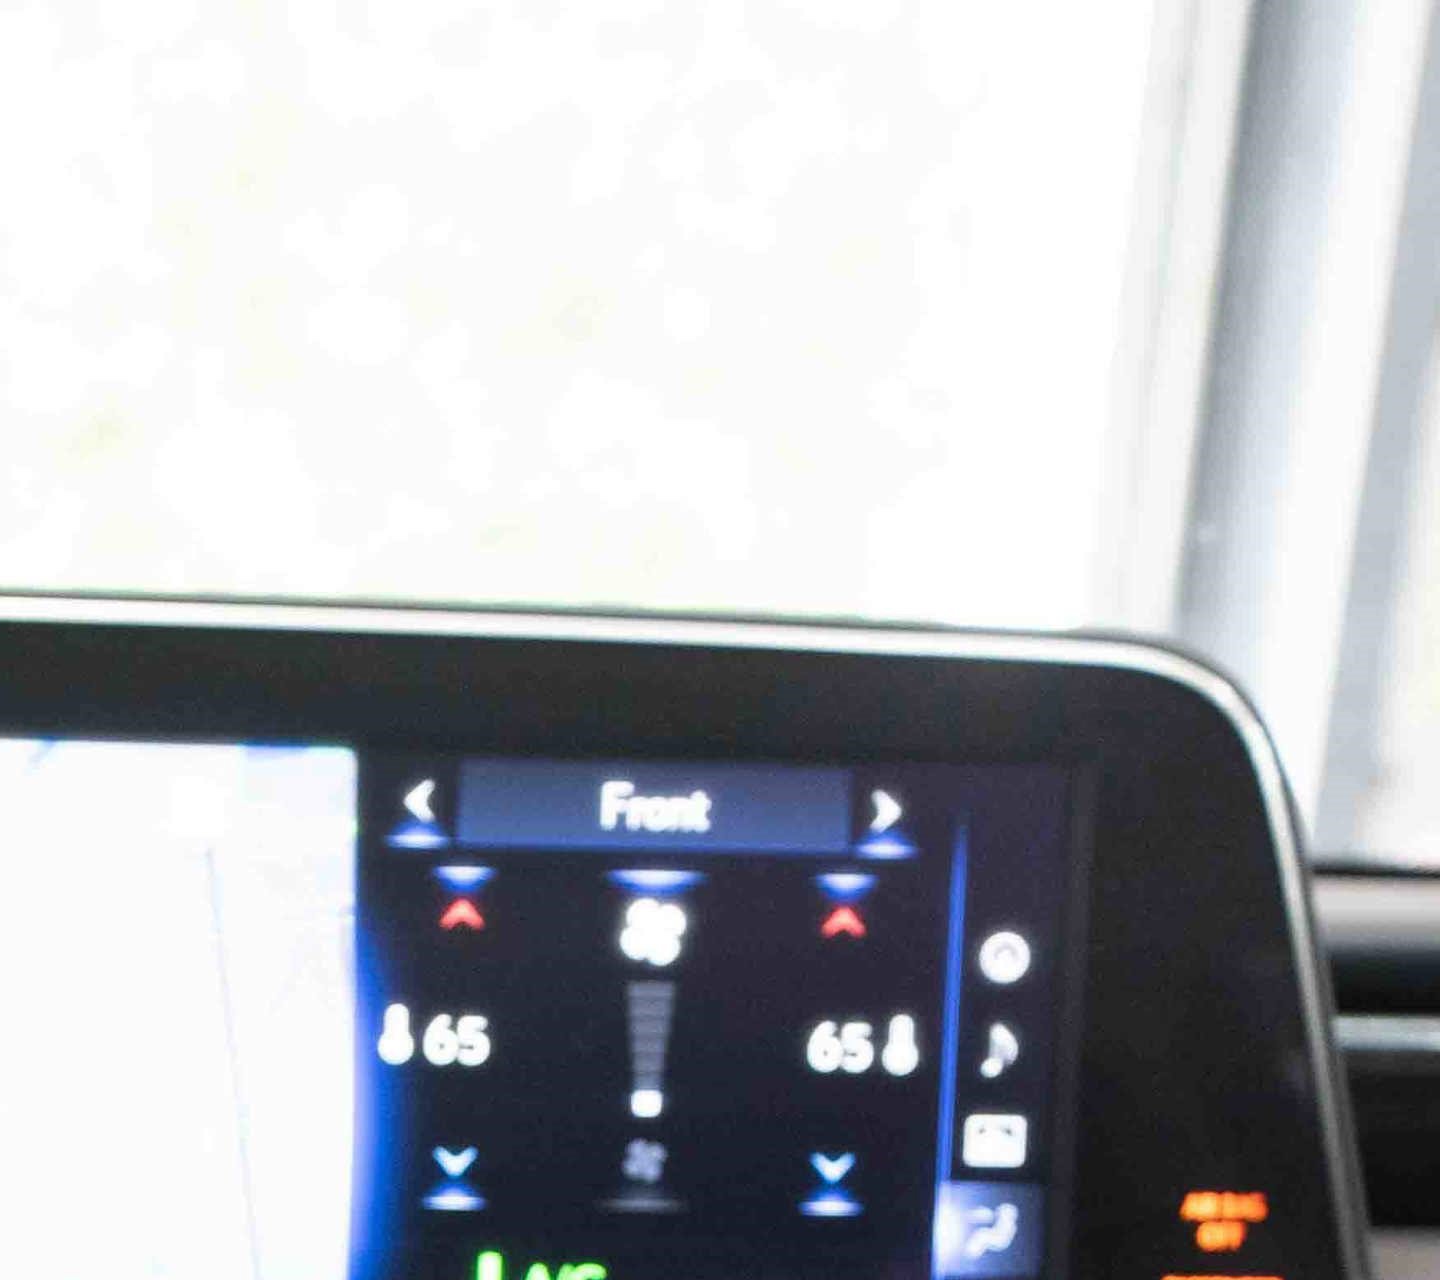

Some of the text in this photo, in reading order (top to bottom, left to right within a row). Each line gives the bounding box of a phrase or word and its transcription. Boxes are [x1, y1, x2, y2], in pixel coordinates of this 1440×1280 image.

[598, 780, 713, 835] Front
[422, 1013, 491, 1067] 65
[806, 1020, 875, 1074] 65
